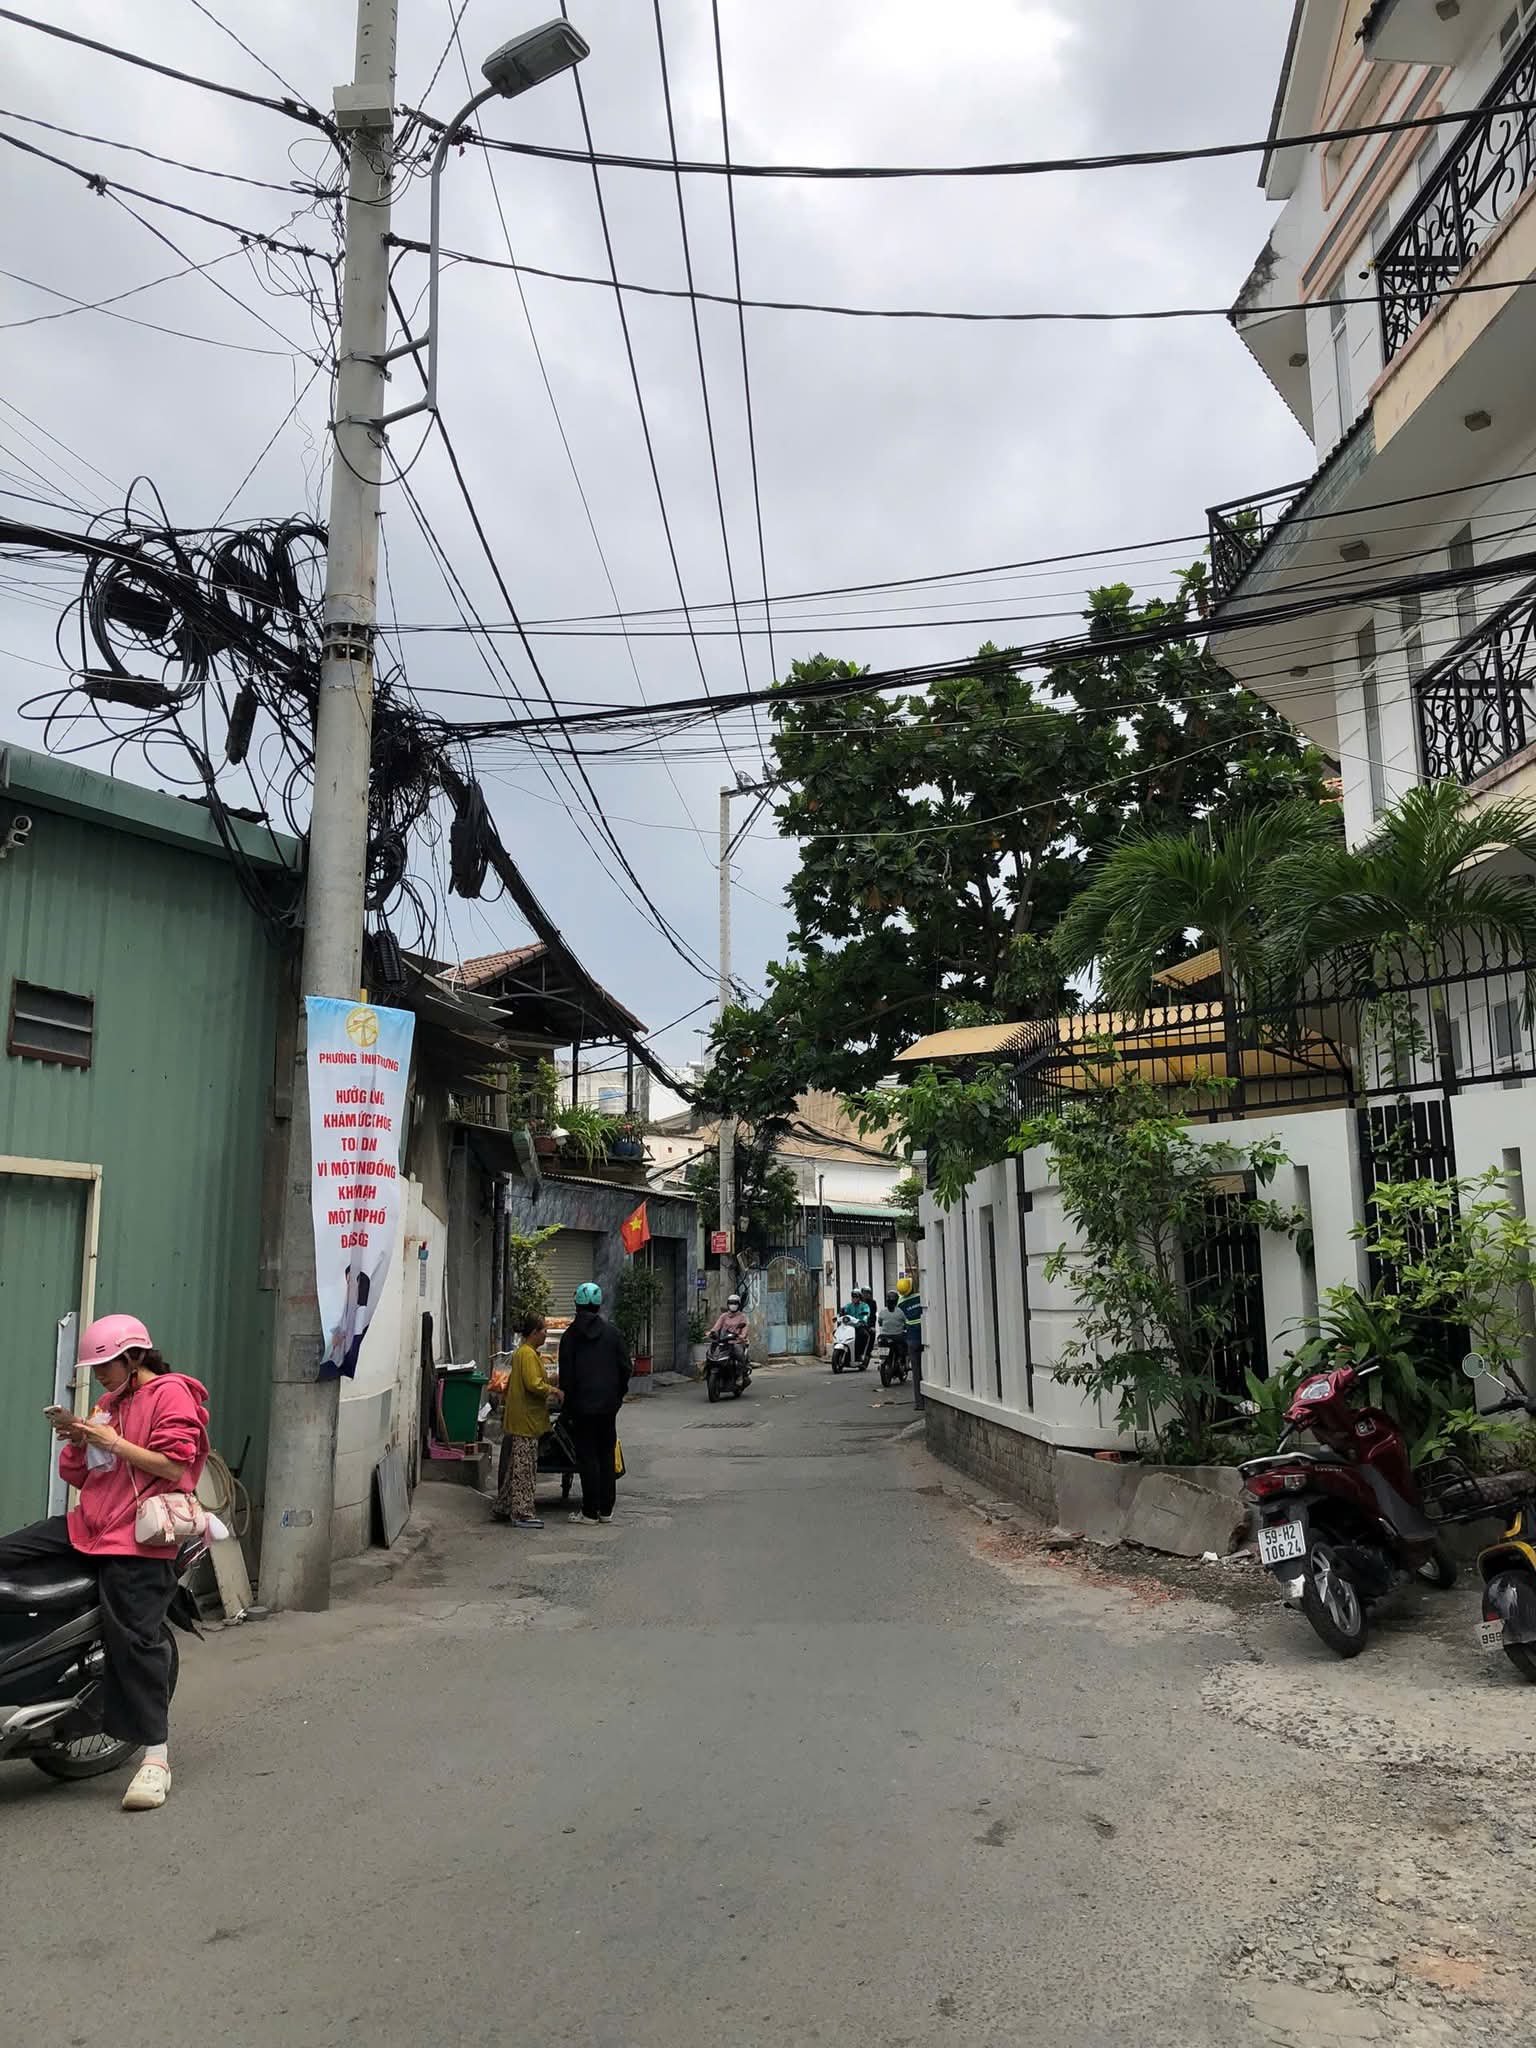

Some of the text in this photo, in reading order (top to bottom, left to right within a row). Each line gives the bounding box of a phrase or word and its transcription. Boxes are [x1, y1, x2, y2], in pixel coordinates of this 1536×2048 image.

[319, 1050, 399, 1072] PHƯỜNG ÌNH TƯNG
[336, 1084, 367, 1104] HƯỞG
[357, 1110, 372, 1127] ỨC
[341, 1136, 377, 1152] TO DN
[317, 1160, 328, 1177] VÌ
[331, 1158, 355, 1179] MỘT
[328, 1207, 352, 1227] MỘT
[1264, 1524, 1296, 1546] 59-H2
[1265, 1539, 1302, 1561] 106.24
